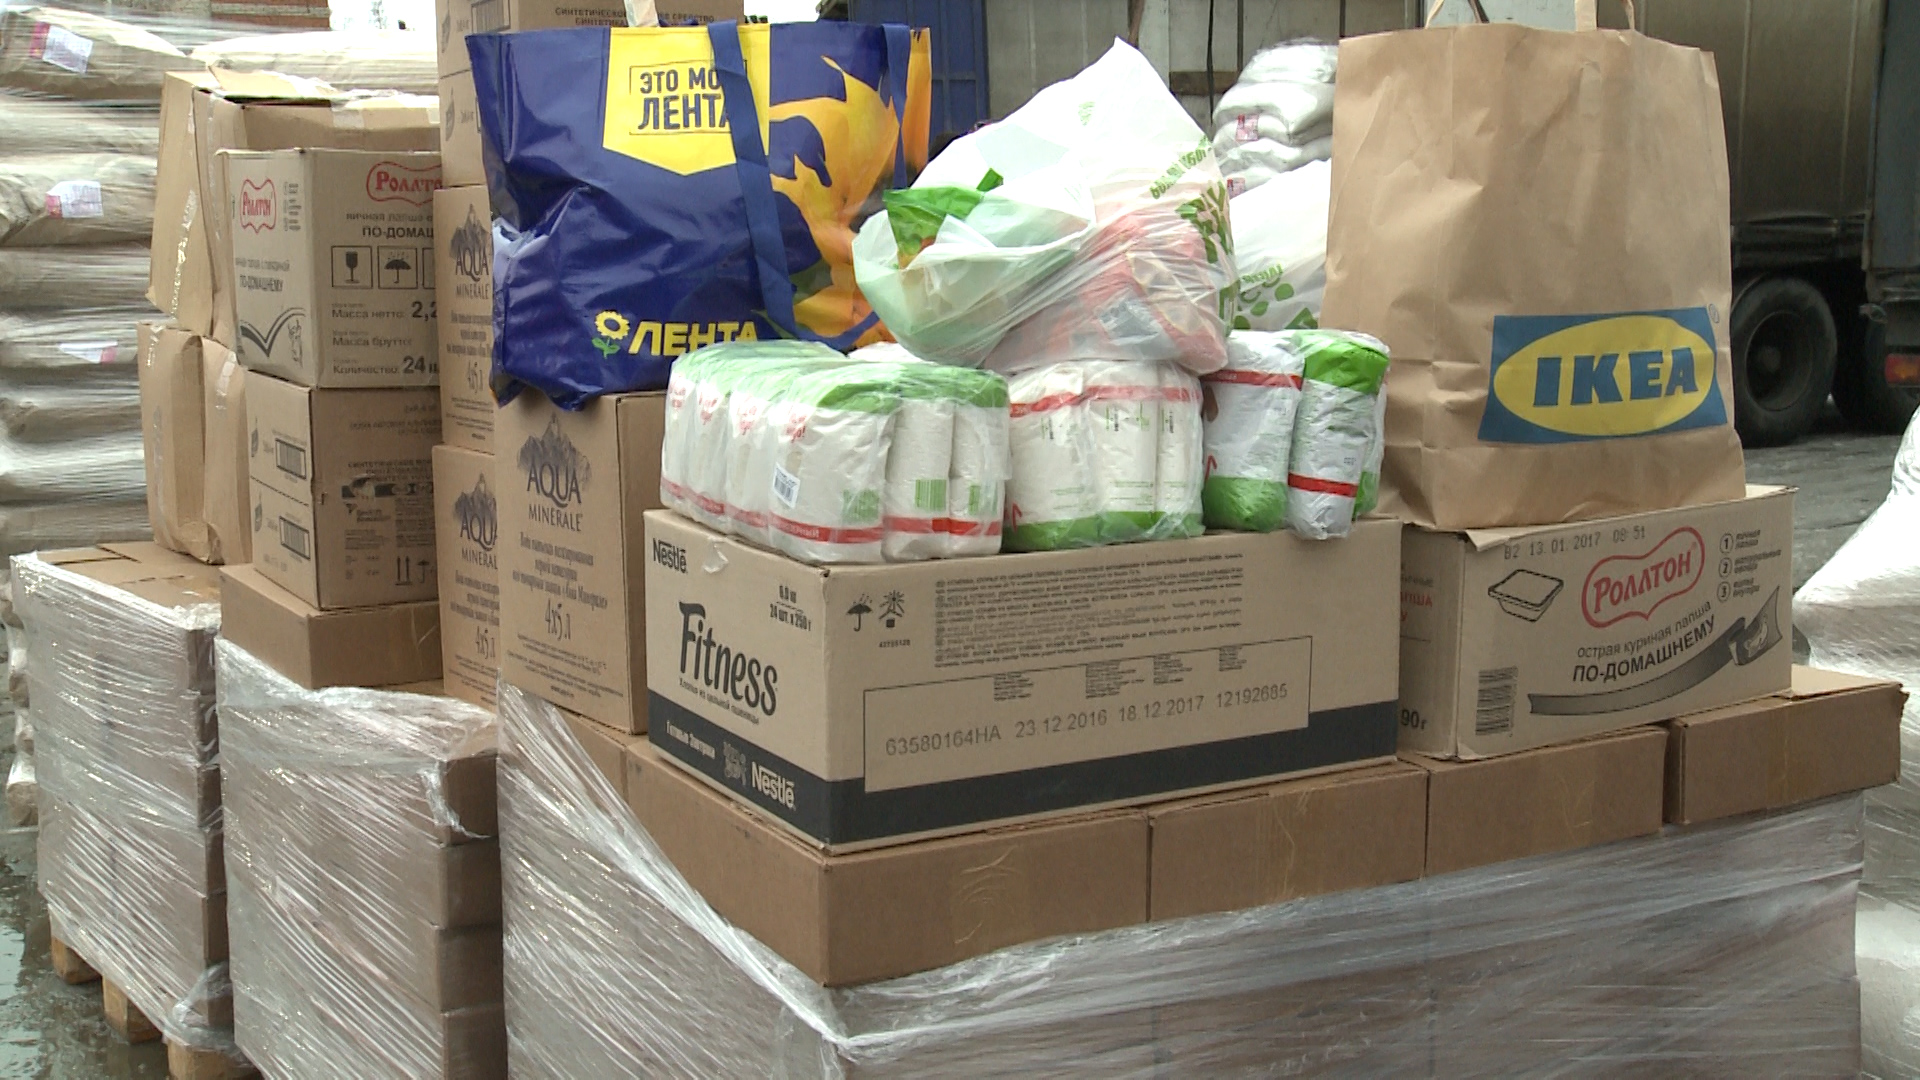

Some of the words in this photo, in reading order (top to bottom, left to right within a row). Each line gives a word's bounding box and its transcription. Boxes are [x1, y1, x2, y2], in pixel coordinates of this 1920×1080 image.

[640, 69, 679, 94] ЭТО
[688, 67, 722, 90] МО
[362, 225, 434, 239] ПО-ДОМАШ
[456, 243, 489, 282] AQUA
[628, 320, 758, 356] ЛЕНТА
[403, 355, 426, 374] 24
[1533, 347, 1698, 408] IKEA
[526, 456, 582, 508] AQUA
[528, 503, 583, 532] MINERALE
[461, 547, 498, 570] MINERAL
[653, 538, 687, 574] Nestlé
[1572, 614, 1715, 684] ПО-ДОМАШНЕМУ
[1577, 644, 1622, 660] острая
[1624, 625, 1672, 656] куриная
[1675, 601, 1712, 632] лапша
[678, 601, 778, 716] Fitness
[885, 725, 1002, 756] 63580164HA
[1118, 695, 1204, 722] 18.12.2017
[751, 761, 796, 809] Nestlé
